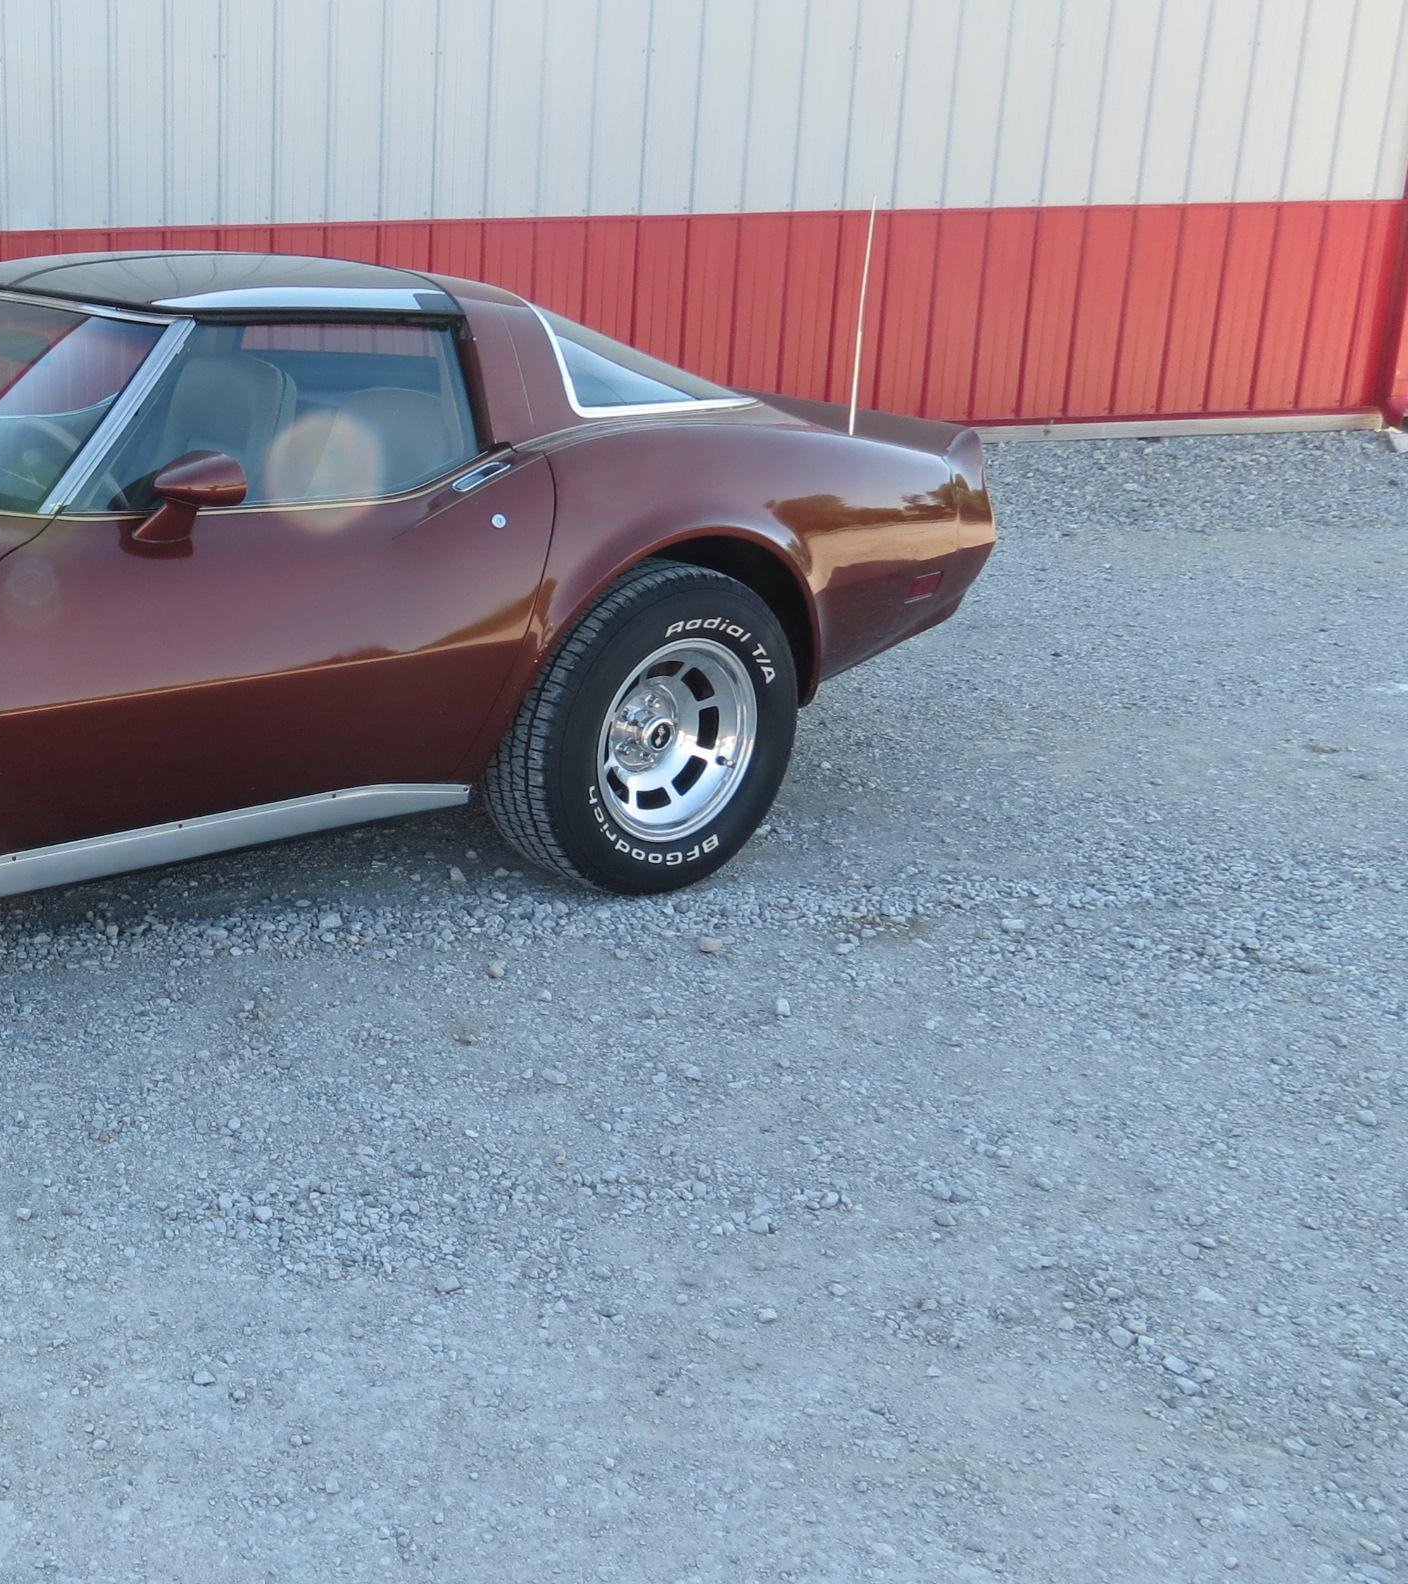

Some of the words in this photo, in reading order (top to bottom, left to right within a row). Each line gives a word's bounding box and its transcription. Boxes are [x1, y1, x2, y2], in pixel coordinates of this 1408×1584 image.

[664, 616, 751, 643] Radial
[750, 642, 776, 685] T/A
[588, 785, 720, 866] BFGoodrich
